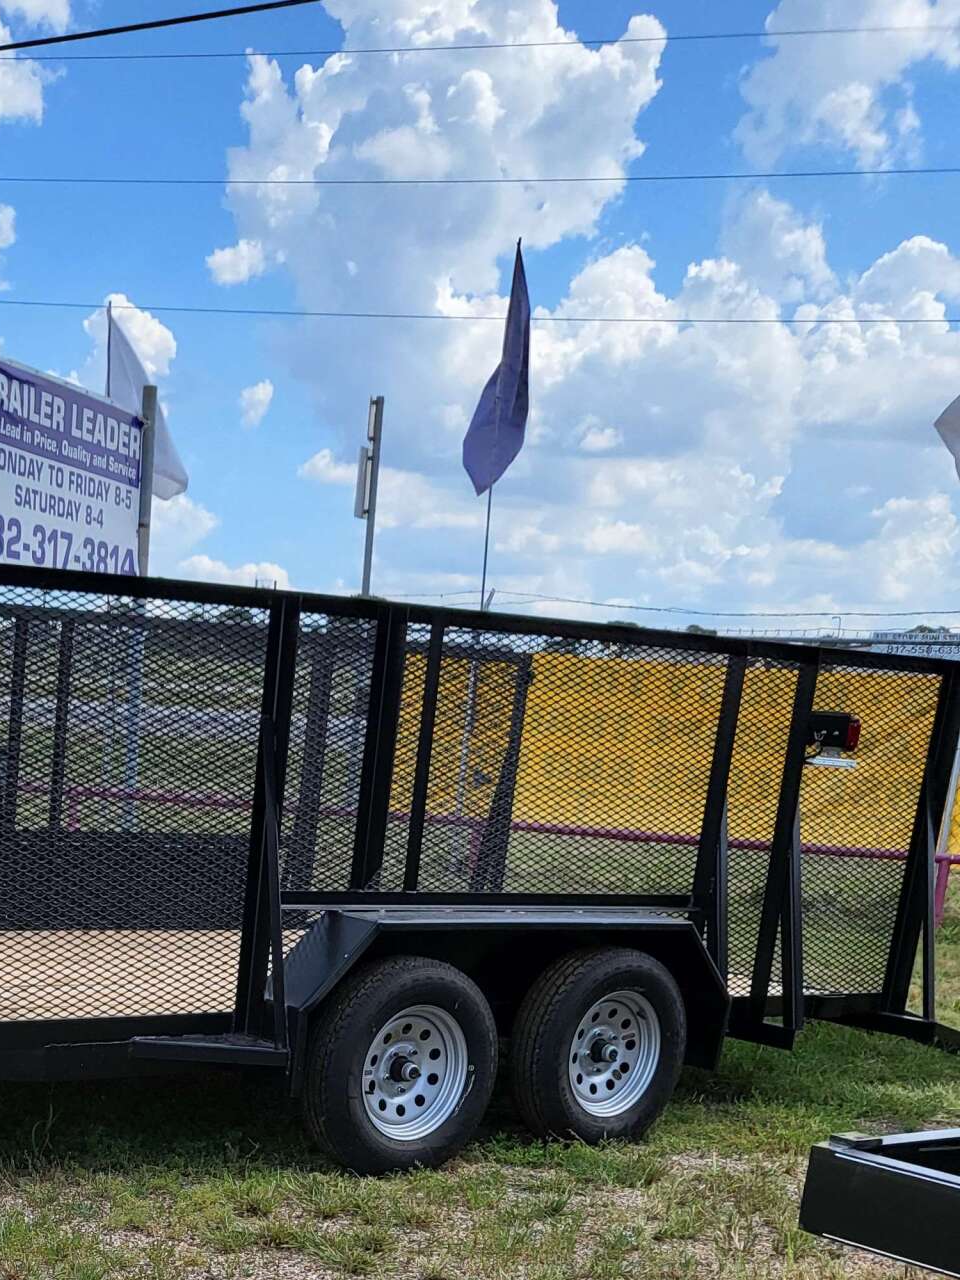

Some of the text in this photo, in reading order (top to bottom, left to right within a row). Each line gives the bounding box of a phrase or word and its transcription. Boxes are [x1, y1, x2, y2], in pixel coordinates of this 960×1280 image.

[0, 417, 20, 440] Lead
[23, 426, 31, 444] in
[34, 430, 58, 456] Price,
[62, 440, 91, 467] Quality
[93, 454, 106, 469] and
[109, 456, 136, 479] Service
[72, 404, 140, 460] LEADER
[15, 484, 103, 529] SATURDAY 8-4
[48, 464, 63, 488] TO
[68, 471, 110, 502] FRIDAY
[114, 488, 132, 510] 8-5
